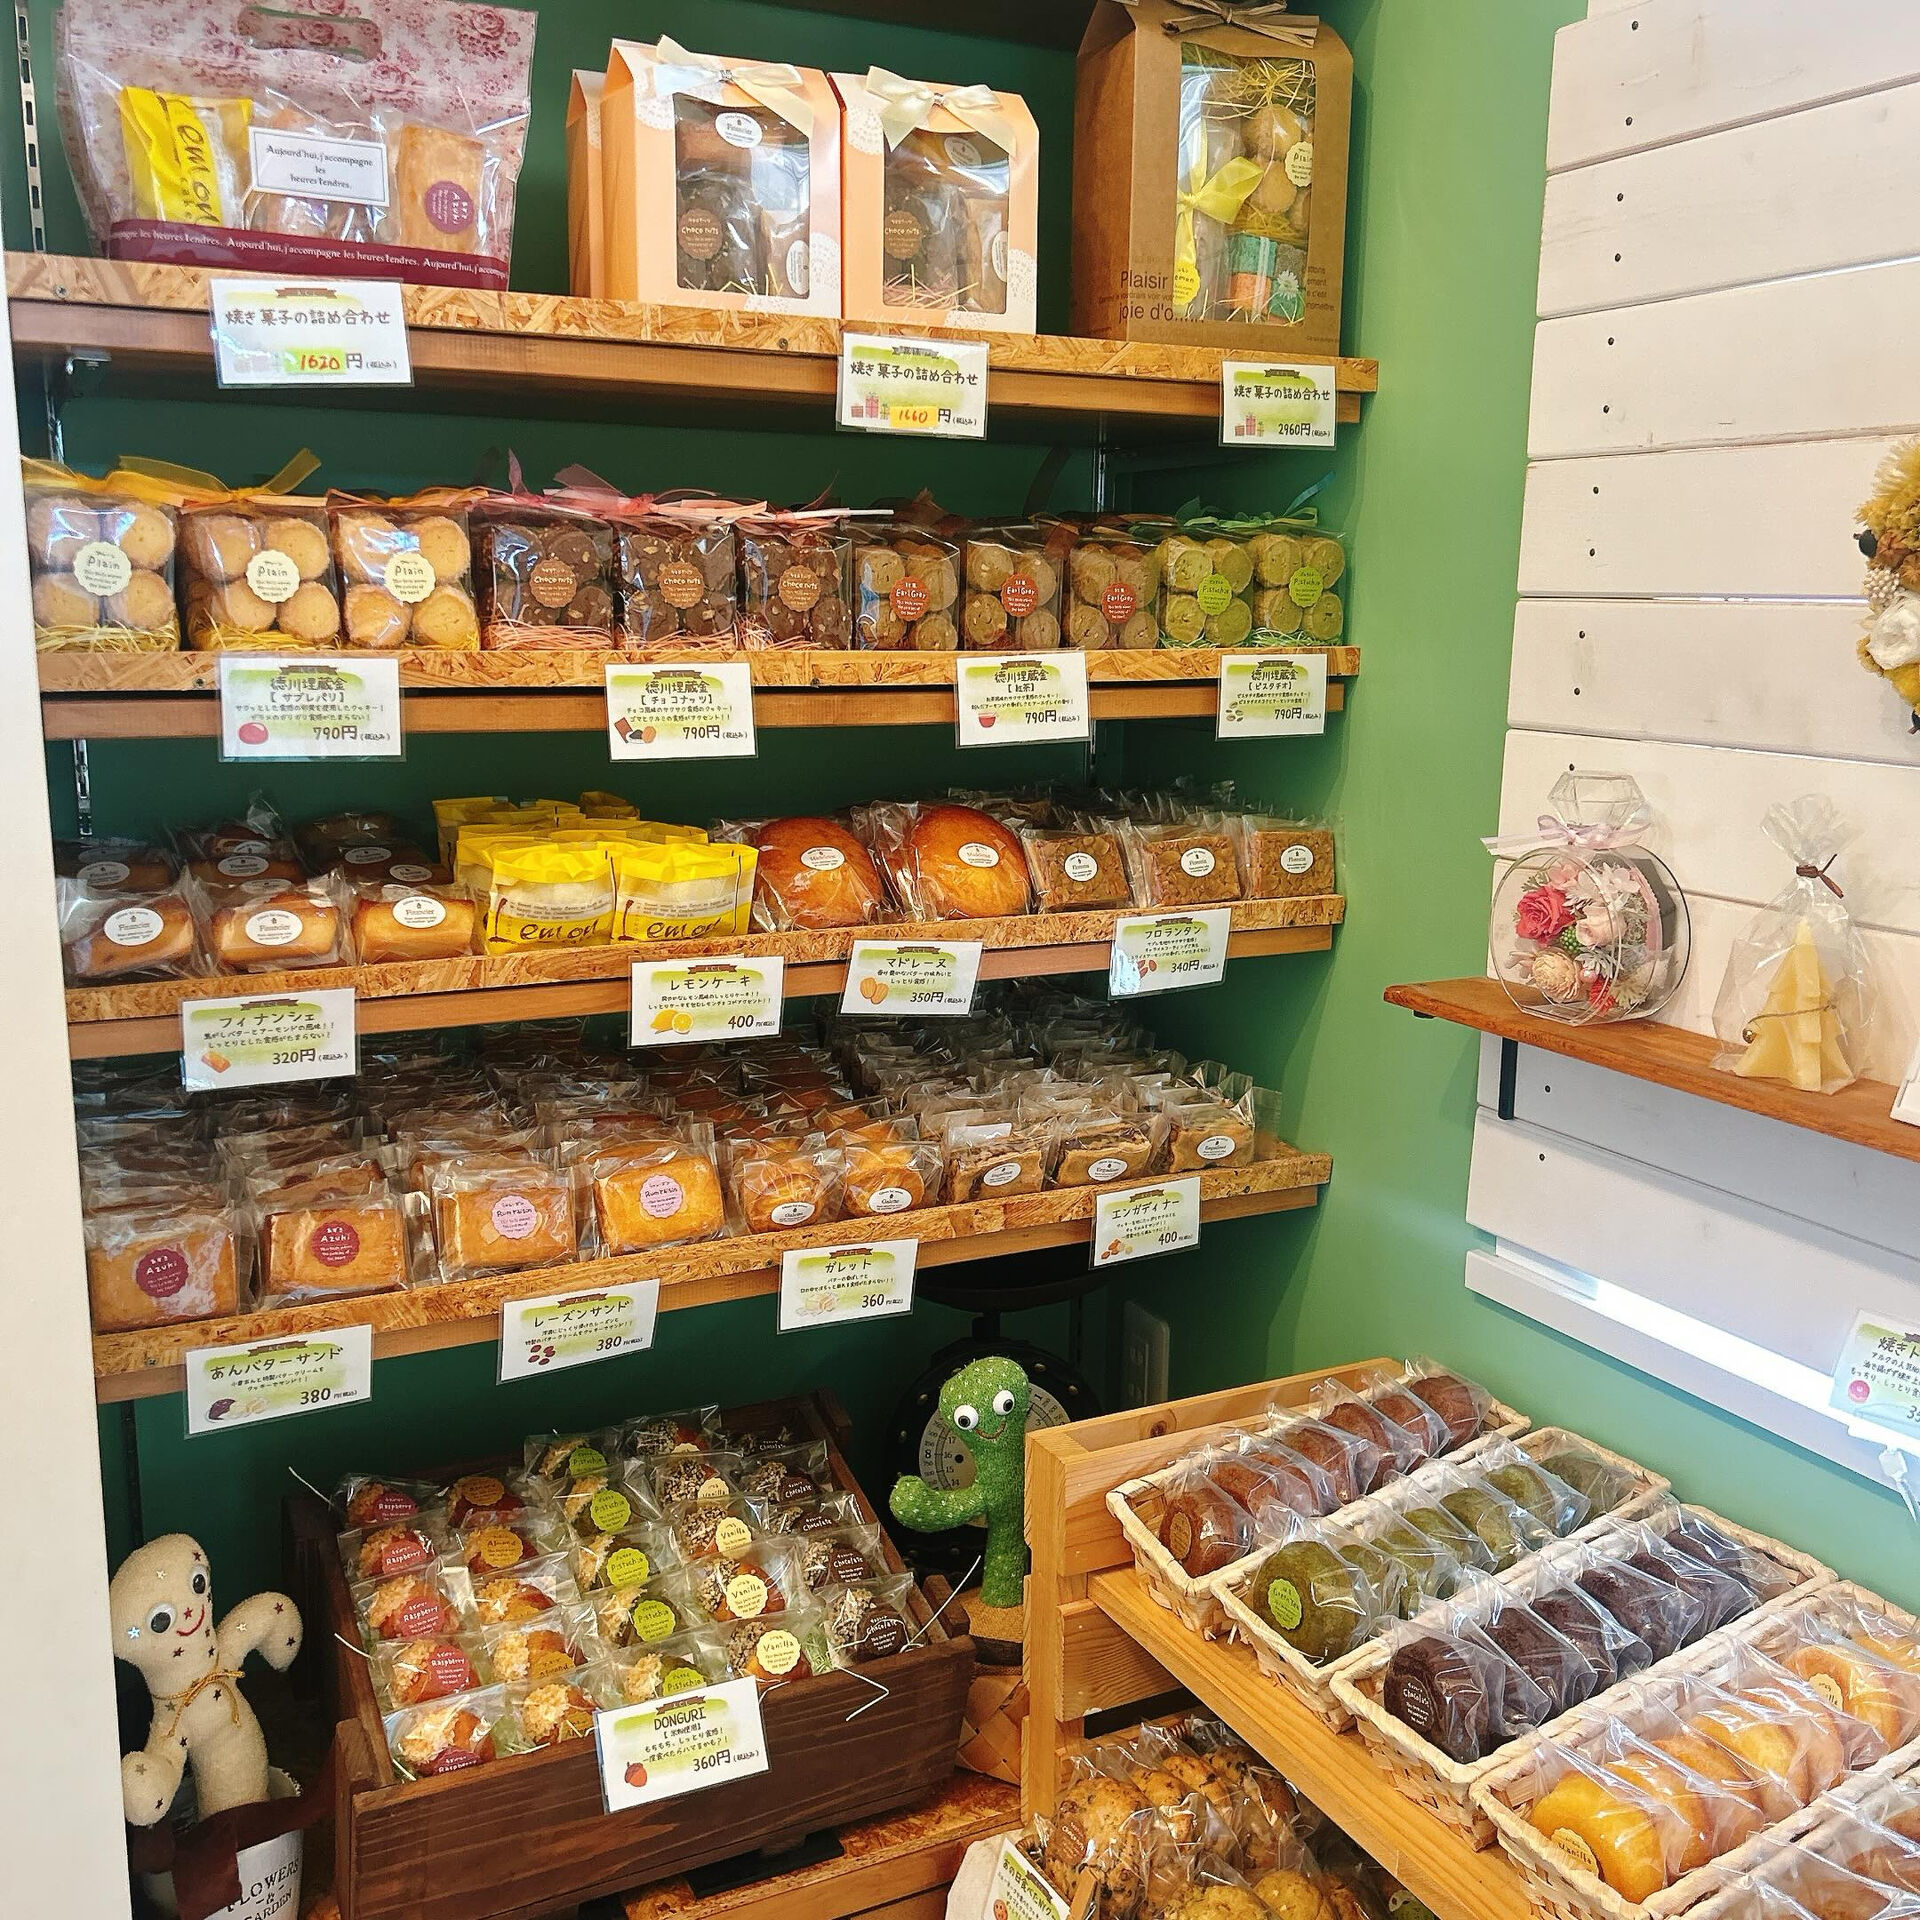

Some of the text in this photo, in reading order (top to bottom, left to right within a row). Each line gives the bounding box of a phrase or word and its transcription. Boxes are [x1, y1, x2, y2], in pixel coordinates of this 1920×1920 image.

[1120, 270, 1168, 289] Plaisir
[226, 309, 390, 326] 焼き菓子の詰め合わせ
[1119, 302, 1144, 324] joie
[300, 353, 340, 370] 1620
[346, 353, 363, 369] 円
[850, 361, 978, 386] 焼き菓子の詰め合わせ
[1234, 385, 1330, 401] 焼き菓子の詰め合わせ
[938, 408, 951, 423] 円
[1278, 423, 1310, 436] 2960円
[88, 555, 120, 569] Plain
[257, 566, 288, 577] Plain
[395, 565, 424, 576] Plain
[534, 576, 574, 585] Choco nuts
[803, 582, 818, 590] nuts
[995, 669, 1049, 683] 徳川埋蔵金
[1251, 669, 1298, 681] 徳川埋蔵金
[271, 676, 347, 691] 徳川埋蔵金
[645, 681, 710, 695] 徳川埋蔵金
[1248, 682, 1292, 691] 【ピスタチオ】
[1025, 710, 1056, 724] 790円
[1275, 707, 1302, 720] 790円
[313, 725, 357, 740] 790円
[683, 725, 719, 739] 790円
[1145, 926, 1201, 939] フロランタン
[886, 958, 947, 969] マドレーヌ
[1171, 960, 1199, 973] 340円
[671, 975, 750, 991] レモンケーキ
[910, 991, 944, 1003] 350円
[220, 1011, 315, 1029] フィナンシェ
[728, 1015, 754, 1030] 400
[273, 1048, 316, 1065] 320円
[1112, 1199, 1180, 1219] エンガディナー
[320, 1234, 350, 1243] Azuki
[1158, 1231, 1178, 1246] 400
[146, 1262, 177, 1275] Azuki
[825, 1258, 872, 1273] ガレット
[862, 1293, 885, 1308] 360
[534, 1300, 630, 1328] レーズンサンド
[596, 1335, 622, 1351] 380
[210, 1347, 344, 1380] あんバターサンド
[300, 1387, 332, 1405] 380
[925, 1450, 932, 1458] 8
[944, 1451, 952, 1459] 16
[785, 1484, 813, 1498] Chocolate
[378, 1502, 412, 1511] Raspberry
[803, 1518, 832, 1532] Chocolate
[720, 1527, 746, 1540] Vanilla
[386, 1551, 421, 1565] Raspberry
[833, 1556, 863, 1568] Chocolate
[731, 1584, 761, 1599] Vanilla
[403, 1605, 438, 1622] Raspberry
[866, 1619, 898, 1635] Chocolate
[764, 1640, 794, 1652] Vanilla
[431, 1658, 465, 1667] Raspberry
[654, 1706, 707, 1730] DONGURI
[438, 1759, 477, 1773] Raspberry
[693, 1749, 731, 1772] 360円
[1559, 1843, 1592, 1865] Vanilla
